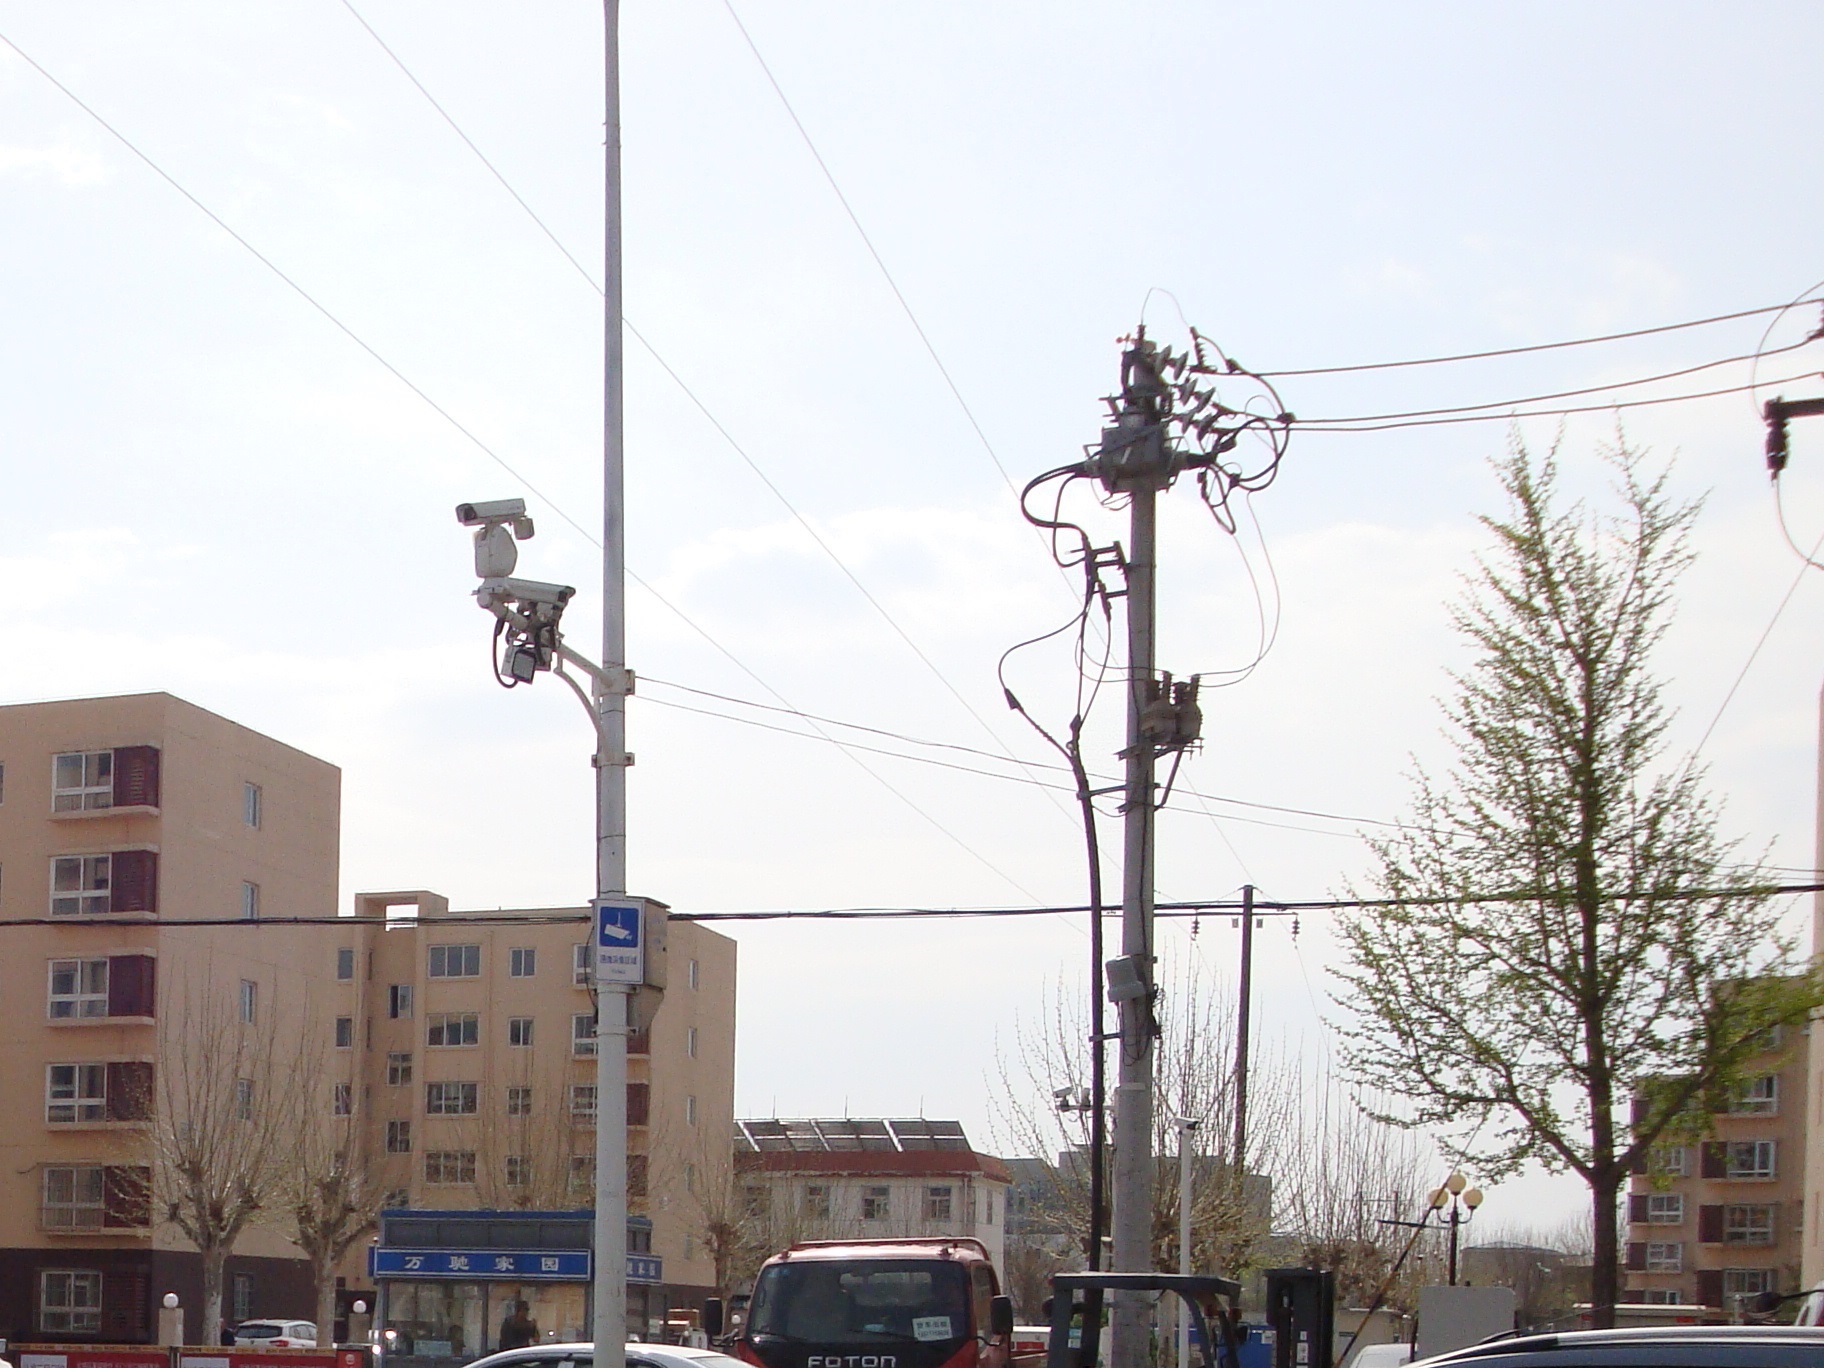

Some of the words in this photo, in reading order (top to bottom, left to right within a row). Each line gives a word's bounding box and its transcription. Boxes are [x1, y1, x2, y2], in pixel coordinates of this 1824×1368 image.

[404, 1255, 560, 1272] 万驰家园
[807, 1355, 897, 1368] FOTON
